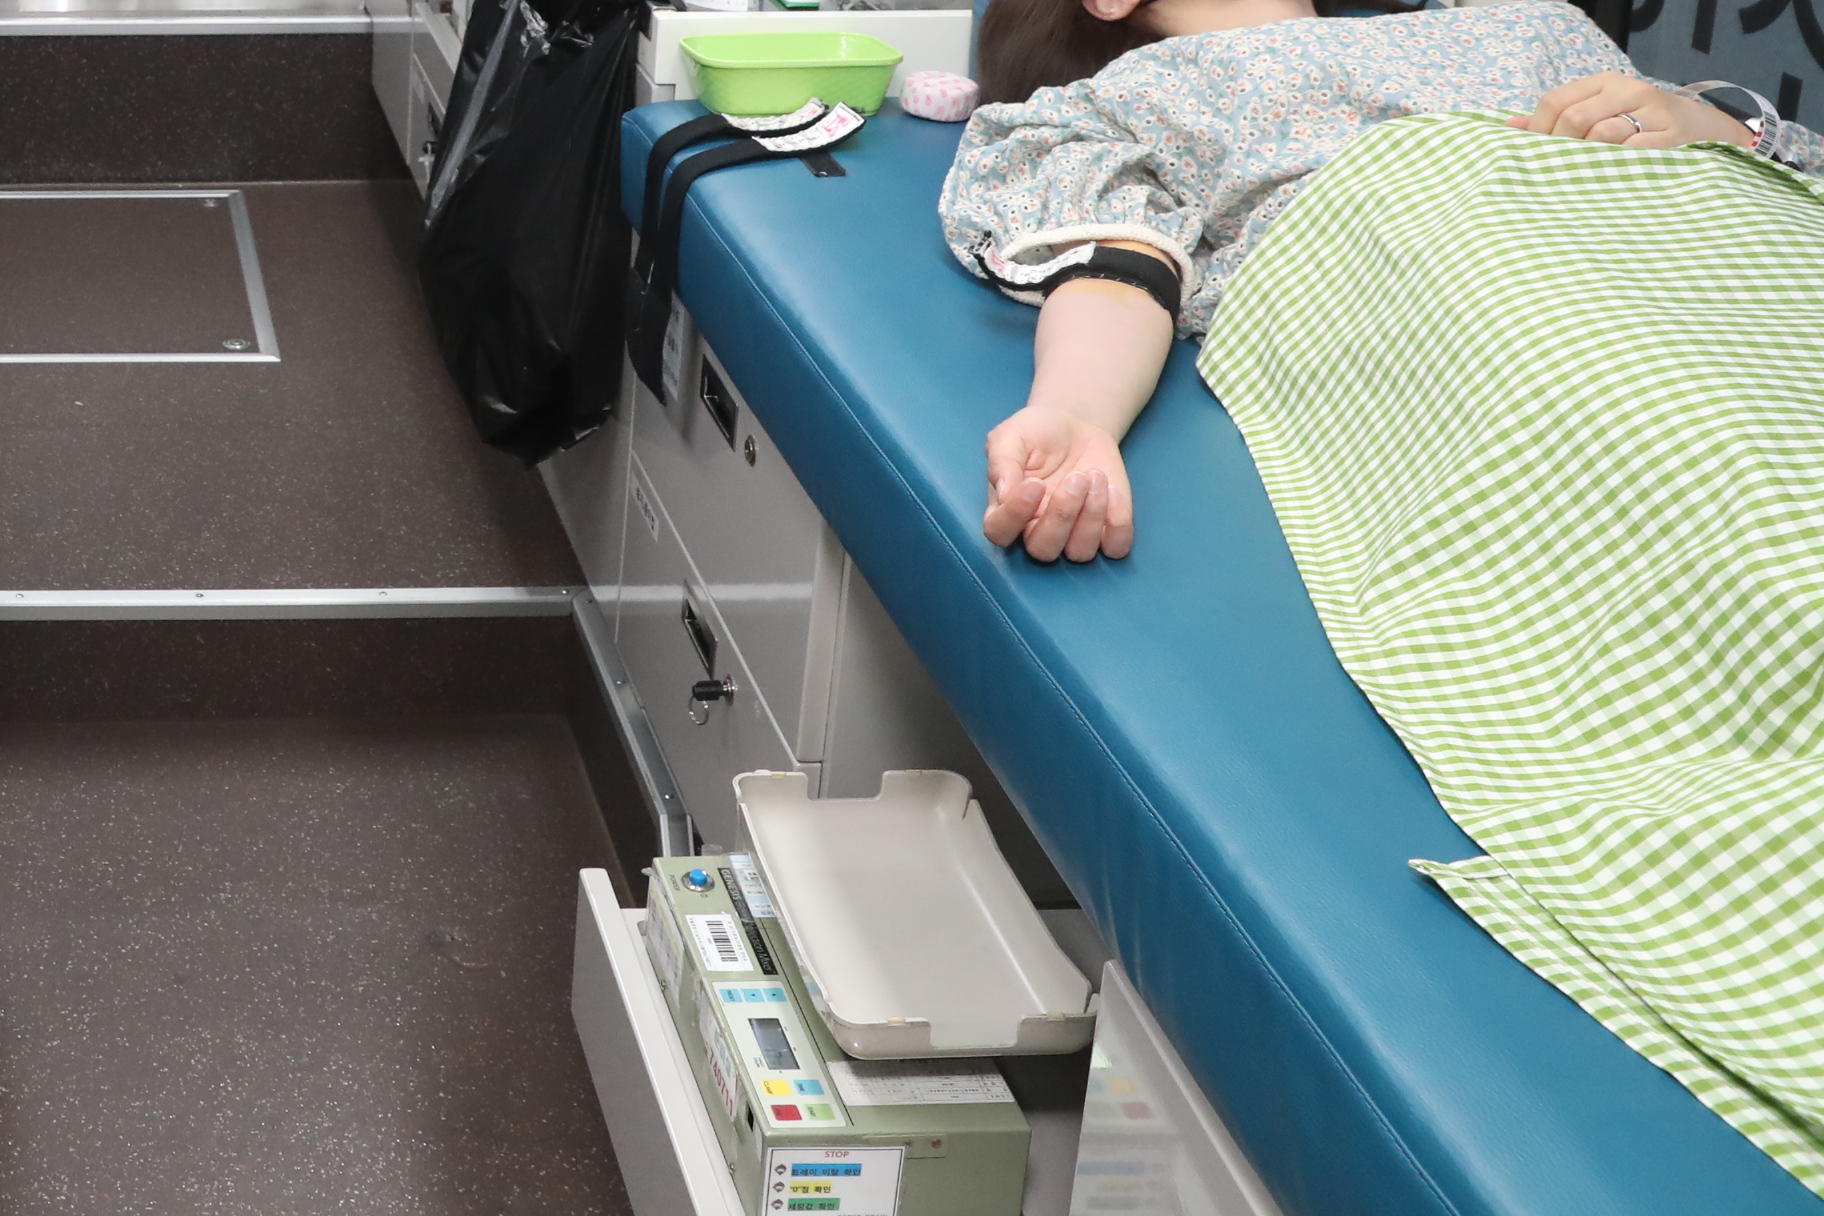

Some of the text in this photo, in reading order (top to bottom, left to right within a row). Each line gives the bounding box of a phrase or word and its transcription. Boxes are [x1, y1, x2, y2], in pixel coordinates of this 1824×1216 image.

[721, 869, 742, 901] GENESIS
[824, 1150, 850, 1159] STOP
[791, 1168, 817, 1177] 트레이
[843, 1167, 862, 1177] 확인
[814, 1185, 832, 1194] 확인
[818, 1202, 836, 1211] 확인
